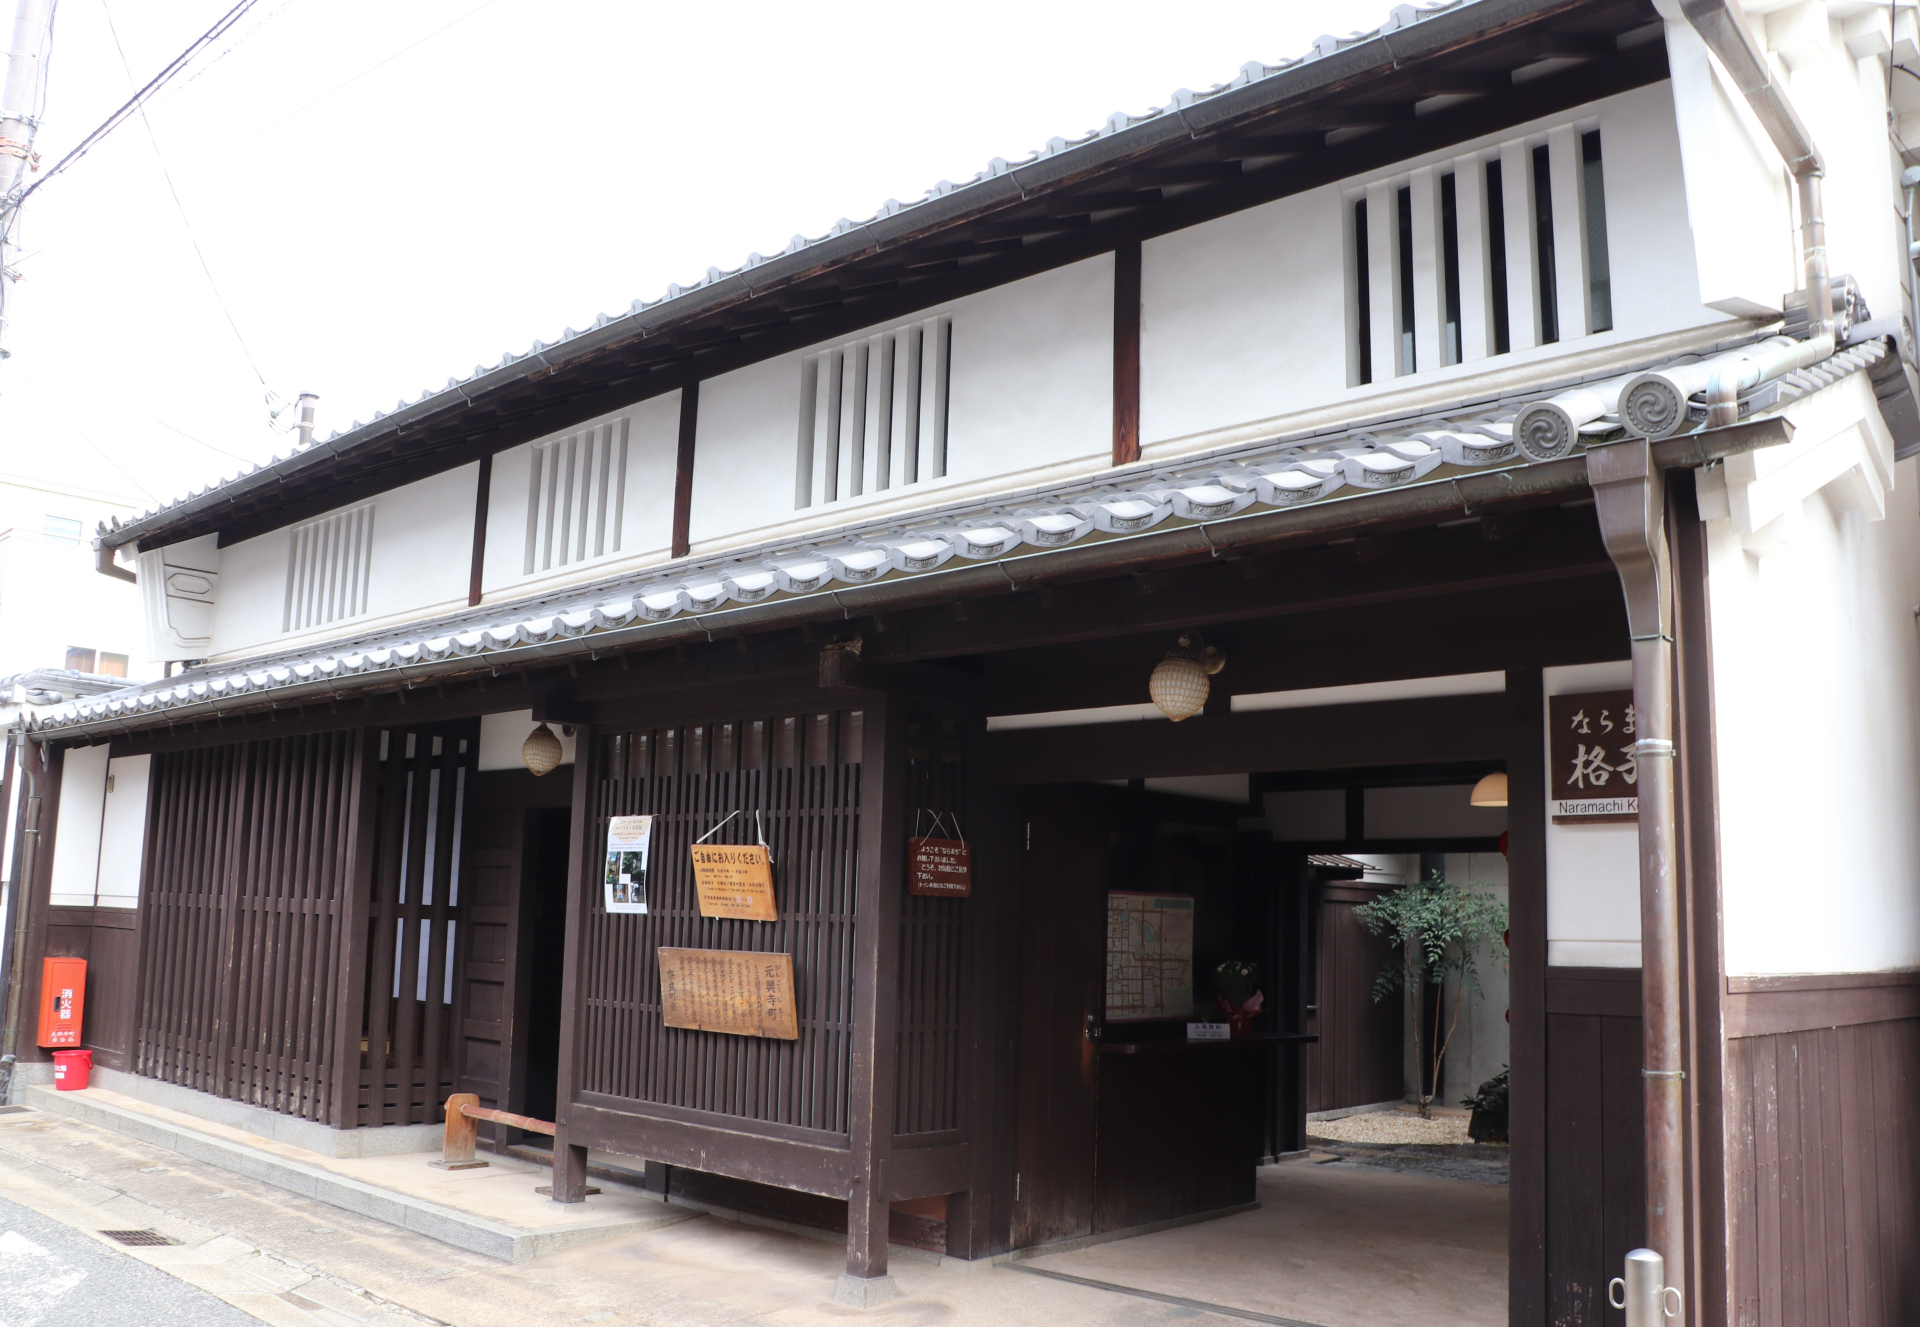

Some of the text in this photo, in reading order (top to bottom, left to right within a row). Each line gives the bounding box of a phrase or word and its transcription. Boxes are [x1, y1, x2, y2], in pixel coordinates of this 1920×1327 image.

[1559, 798, 1638, 814] Naramachi K
[694, 850, 765, 866] ご自由にお入りください。
[60, 988, 73, 1019] 消火器
[764, 964, 777, 1021] 元興寺町
